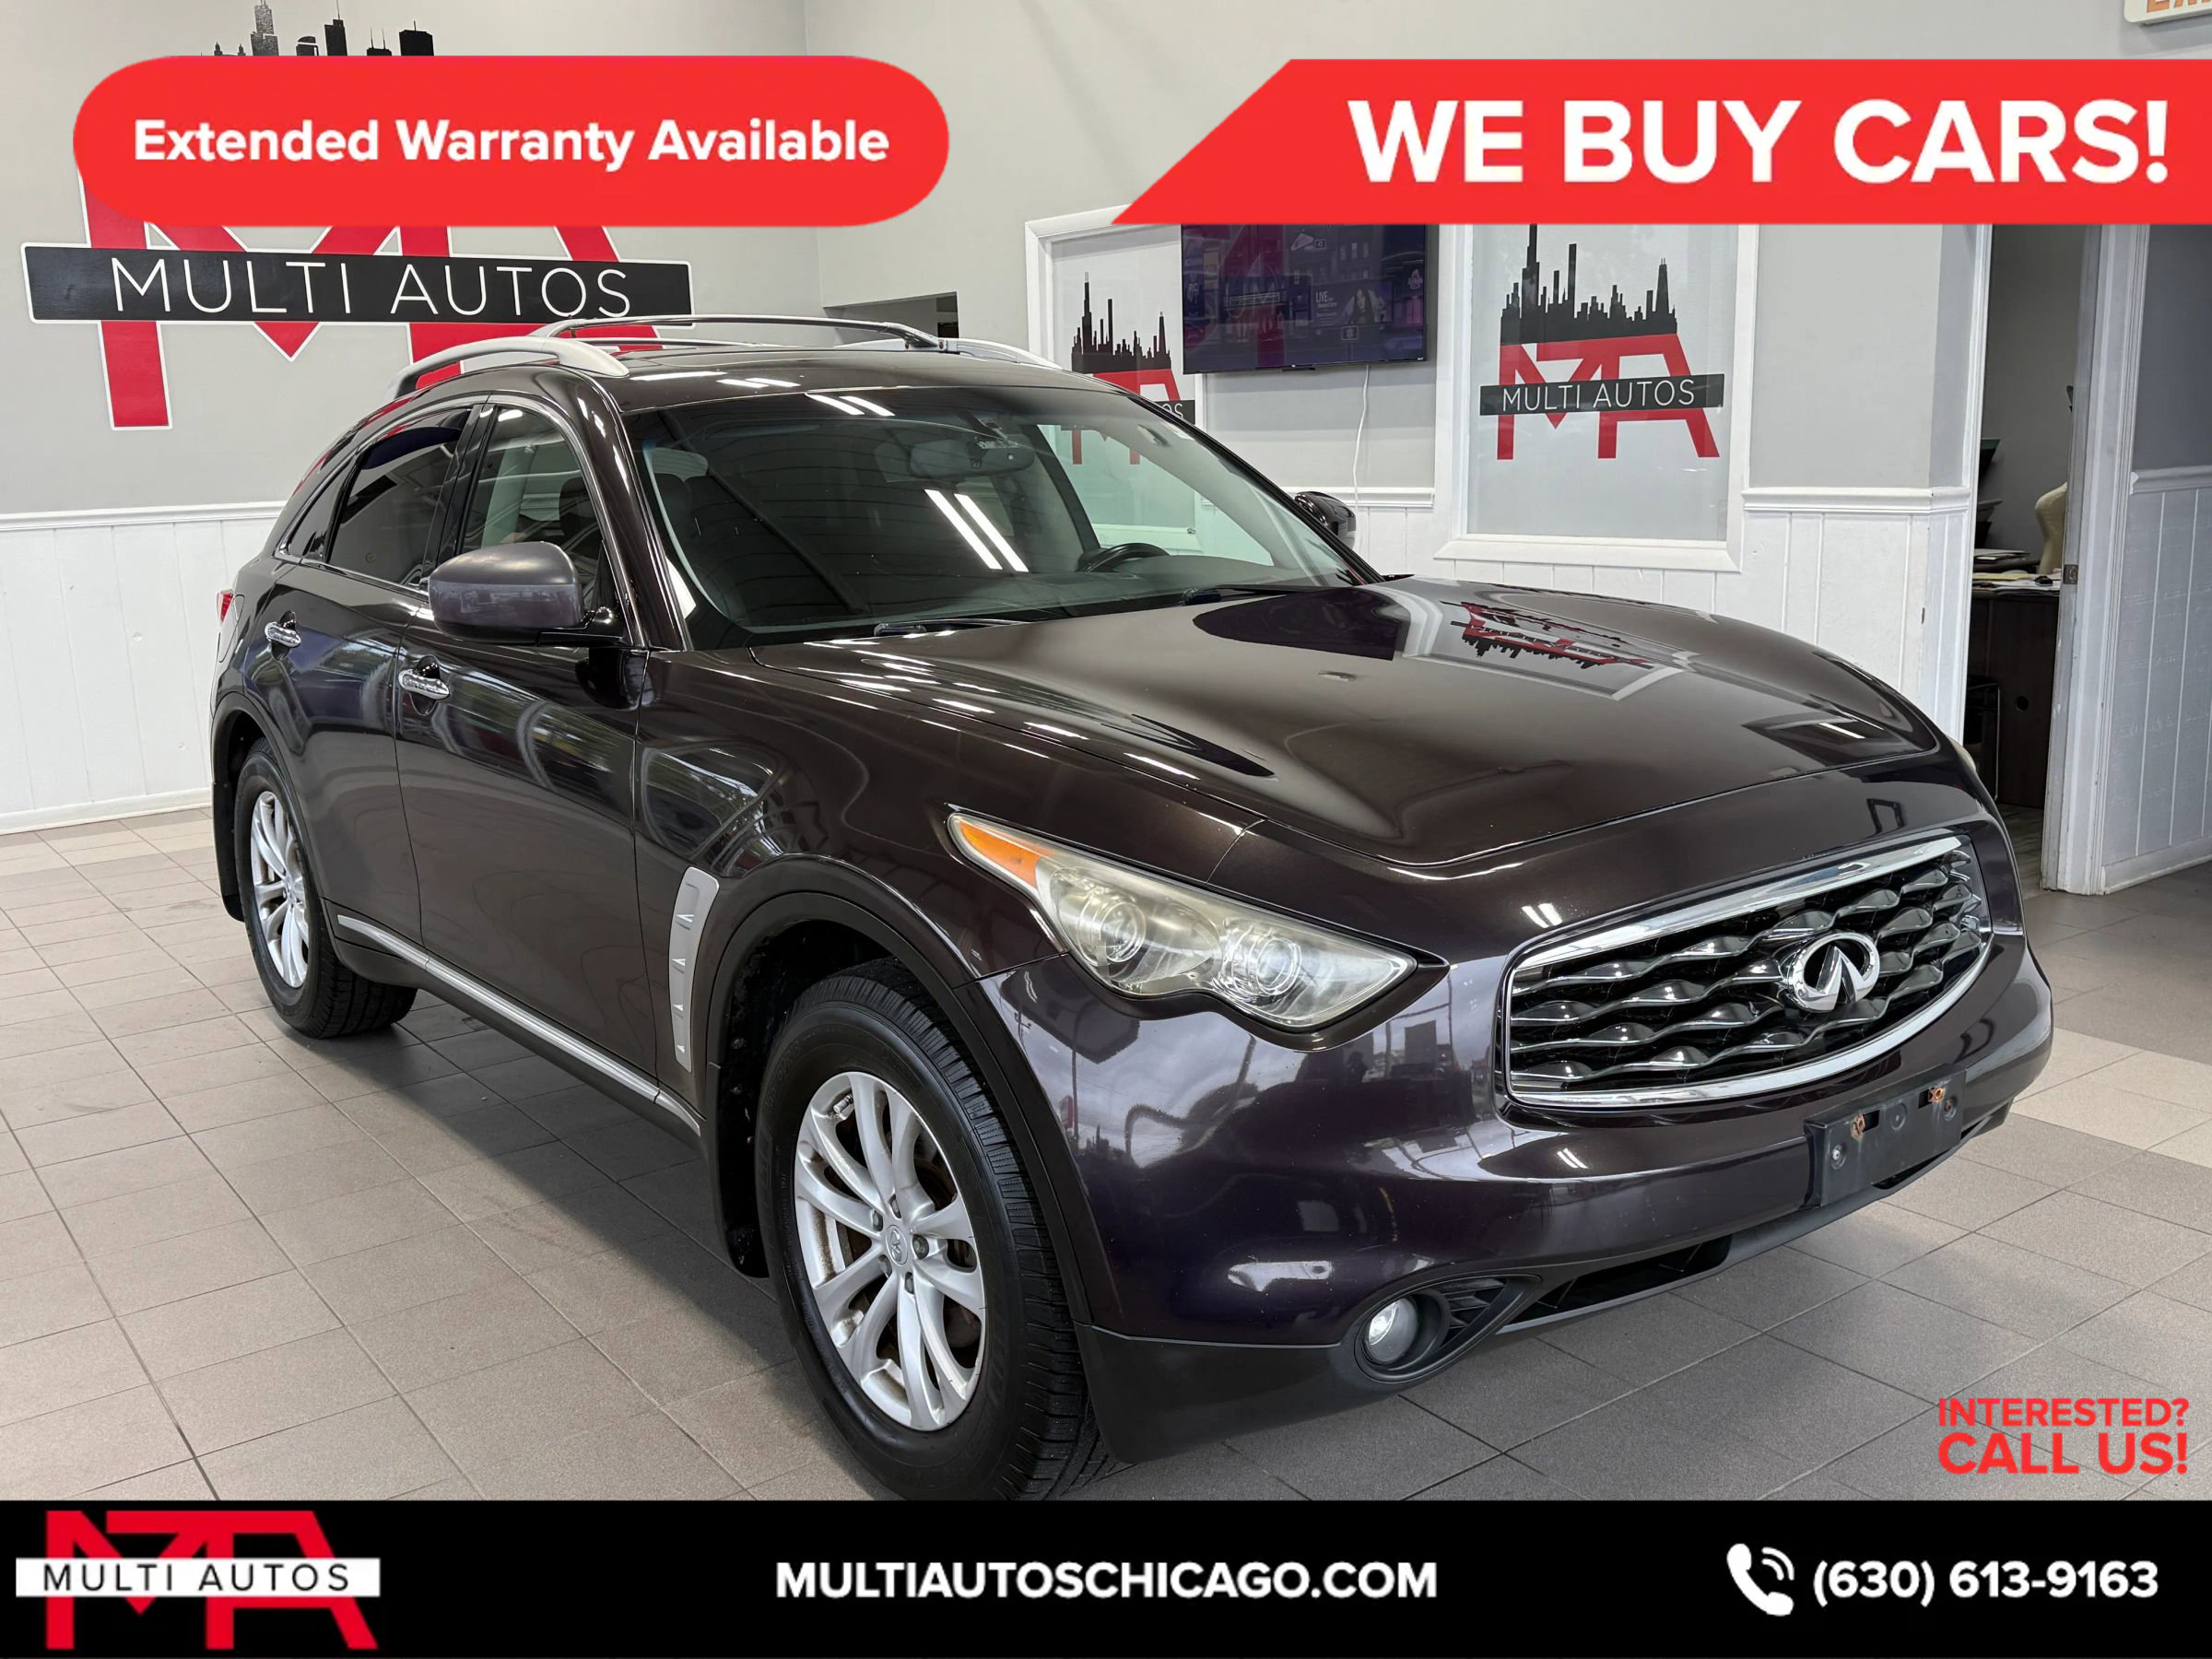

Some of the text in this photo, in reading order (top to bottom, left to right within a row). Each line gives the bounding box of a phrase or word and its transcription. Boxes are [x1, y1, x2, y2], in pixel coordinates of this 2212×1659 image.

[111, 257, 631, 319] MULTI AUTOS
[1502, 378, 1696, 413] MULTI AUTOS
